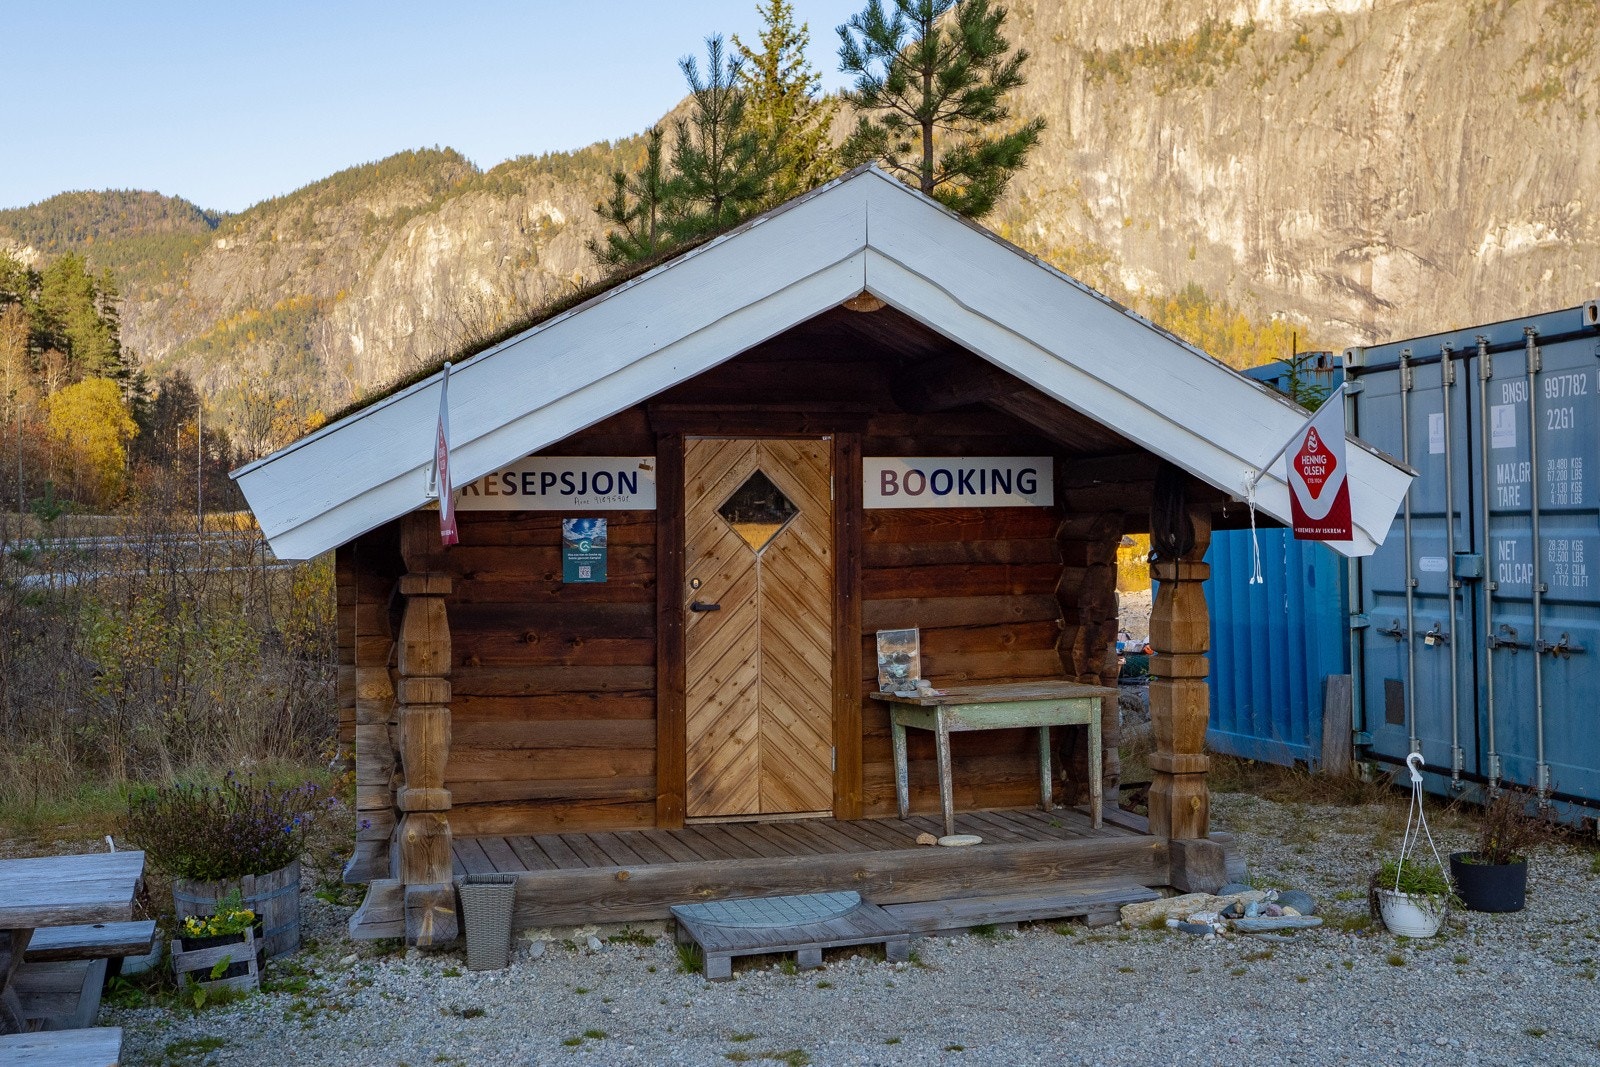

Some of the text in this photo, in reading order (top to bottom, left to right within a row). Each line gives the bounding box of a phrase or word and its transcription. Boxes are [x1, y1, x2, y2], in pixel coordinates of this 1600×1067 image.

[1502, 380, 1529, 404] BNSU
[1544, 373, 1587, 399] 997782
[1547, 406, 1574, 431] 22G1
[1301, 455, 1327, 465] HENNIG
[1496, 461, 1531, 484] MAX.GR
[1570, 457, 1583, 469] KGS
[1303, 466, 1325, 476] OLSEN
[1570, 468, 1583, 481] LBS
[880, 468, 1038, 497] BOOKING
[1497, 485, 1520, 507] TARE
[1570, 481, 1583, 493] KGS
[1570, 493, 1583, 505] LBS
[1498, 540, 1517, 561] NET
[1571, 540, 1584, 551] KGS
[1572, 551, 1584, 563] LBS
[1499, 563, 1534, 584] CU.CAP
